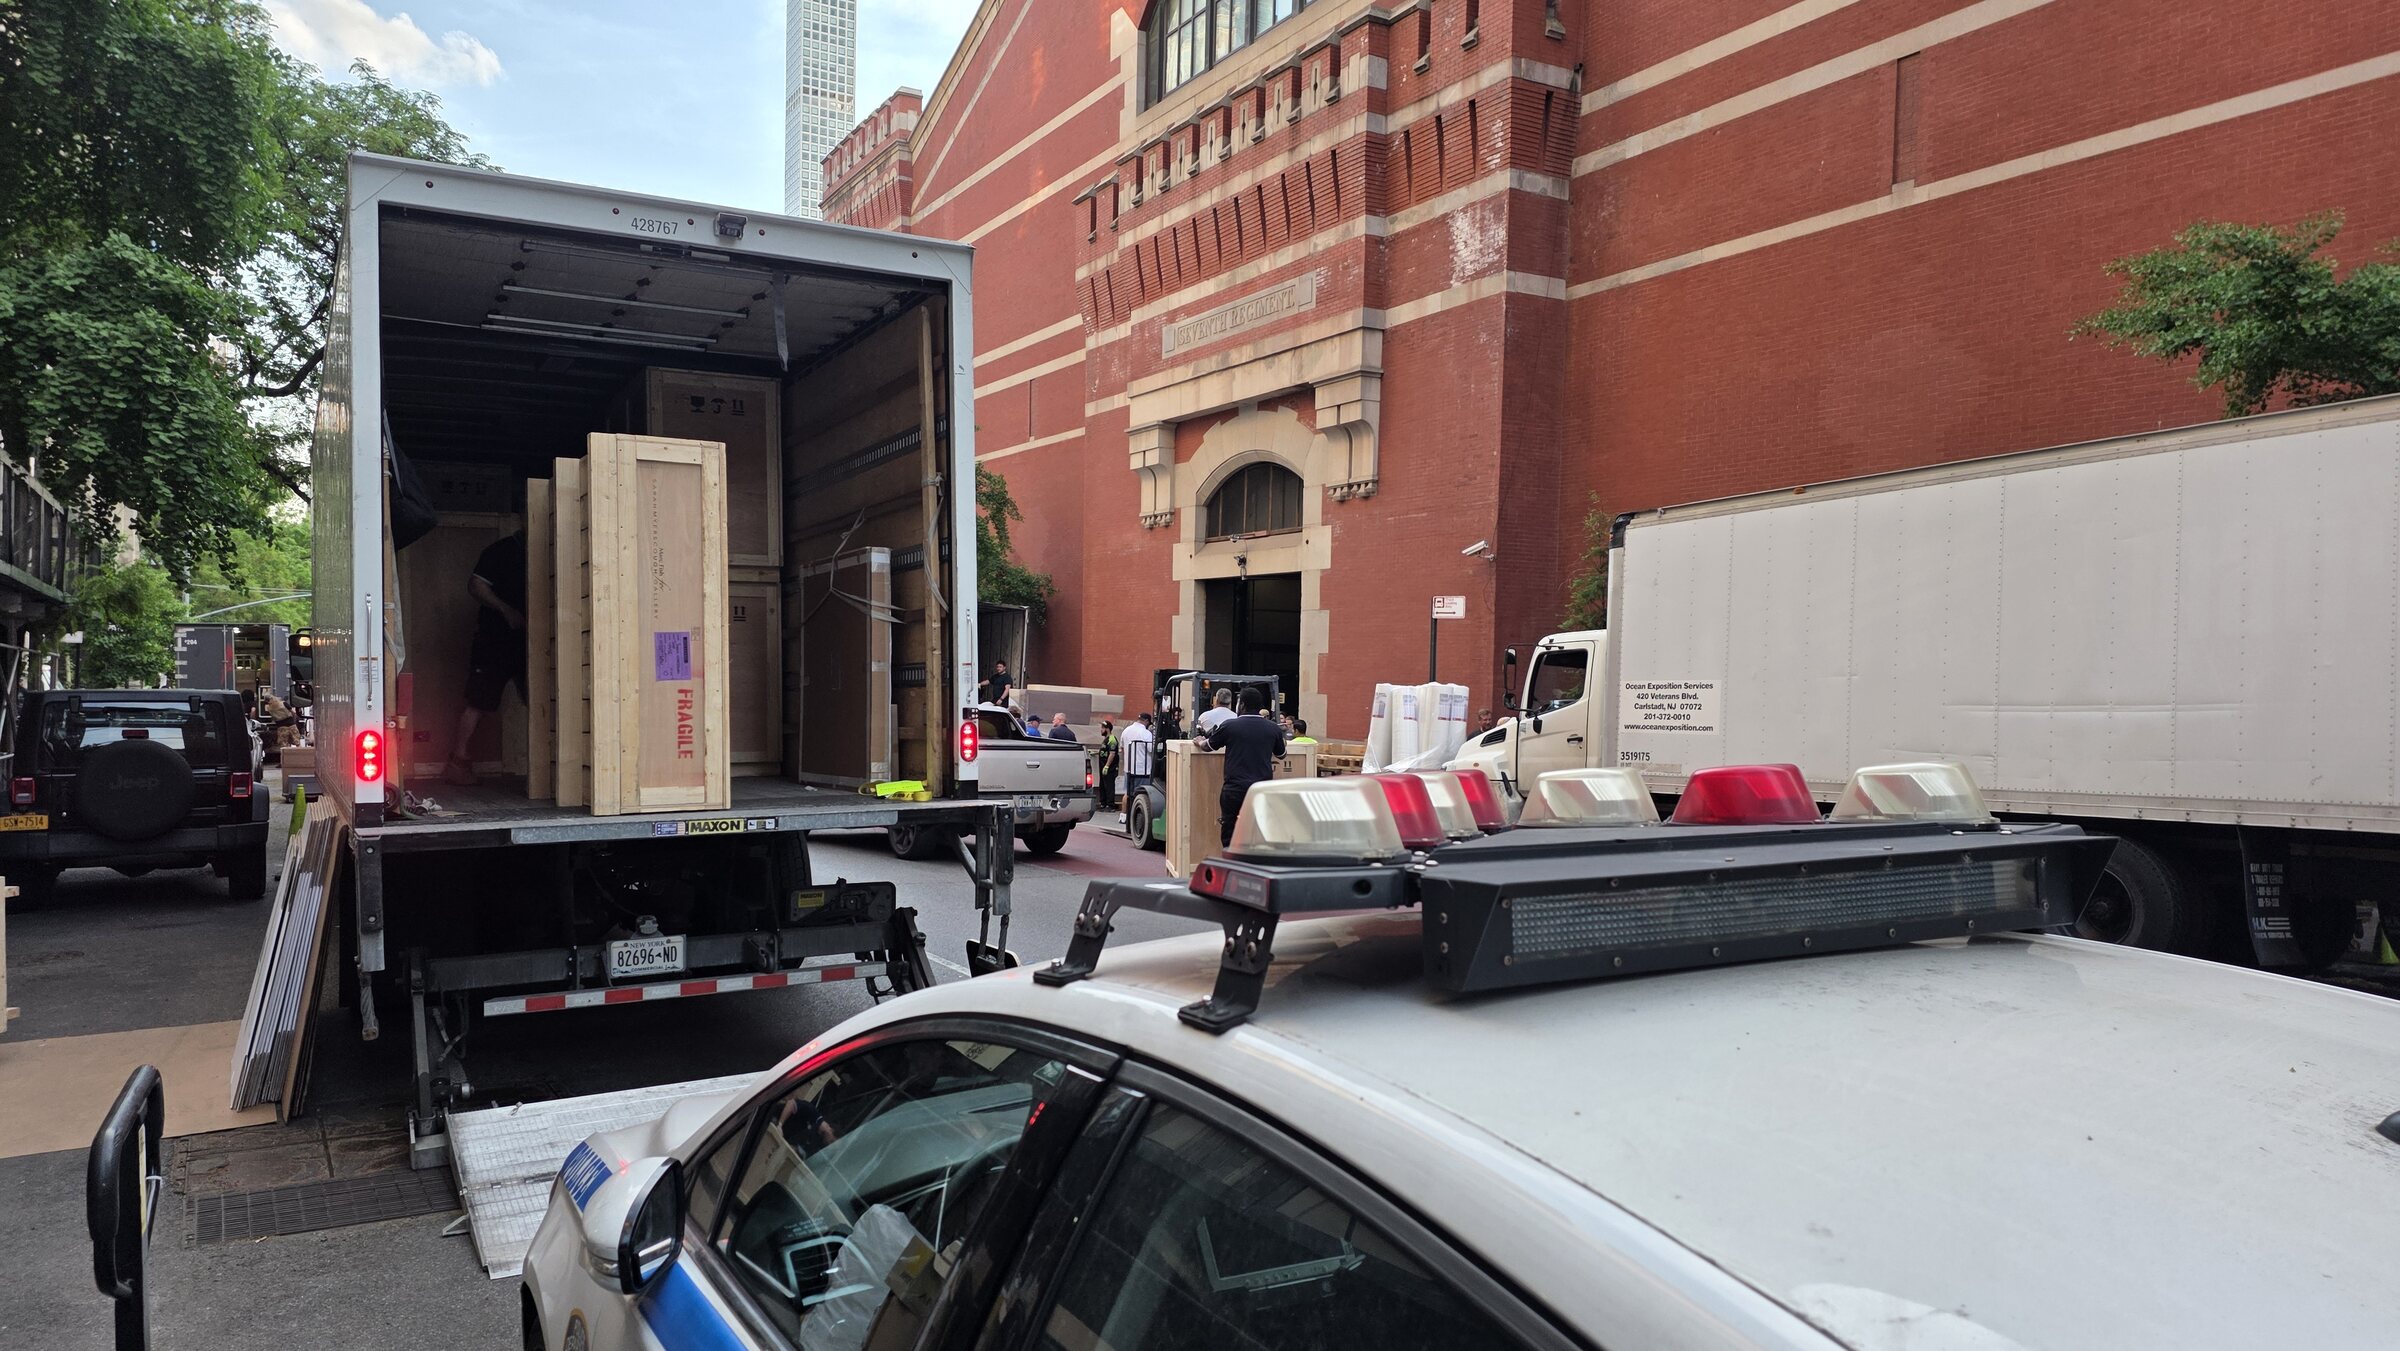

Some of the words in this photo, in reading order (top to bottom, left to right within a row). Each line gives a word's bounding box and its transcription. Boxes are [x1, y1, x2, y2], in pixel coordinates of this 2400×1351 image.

[631, 217, 679, 235] 428767
[1177, 312, 1229, 346] SEVENTH
[1625, 682, 1646, 690] Ocean
[1647, 682, 1682, 690] Exposition
[1683, 682, 1714, 690] Services
[1636, 692, 1649, 700] 420
[1650, 692, 1680, 700] Veterans
[1681, 692, 1699, 700] Blvd.
[1634, 702, 1666, 711] Carlstadt,
[1680, 703, 1702, 711] 07072
[1644, 713, 1691, 721] 201-372-0010
[677, 688, 693, 760] FRAGILE
[1624, 723, 1714, 732] www.oceanexposition.com
[1620, 751, 1651, 761] 3519175
[690, 820, 740, 833] MAXON
[629, 942, 646, 950] NEW
[647, 940, 666, 949] YORK
